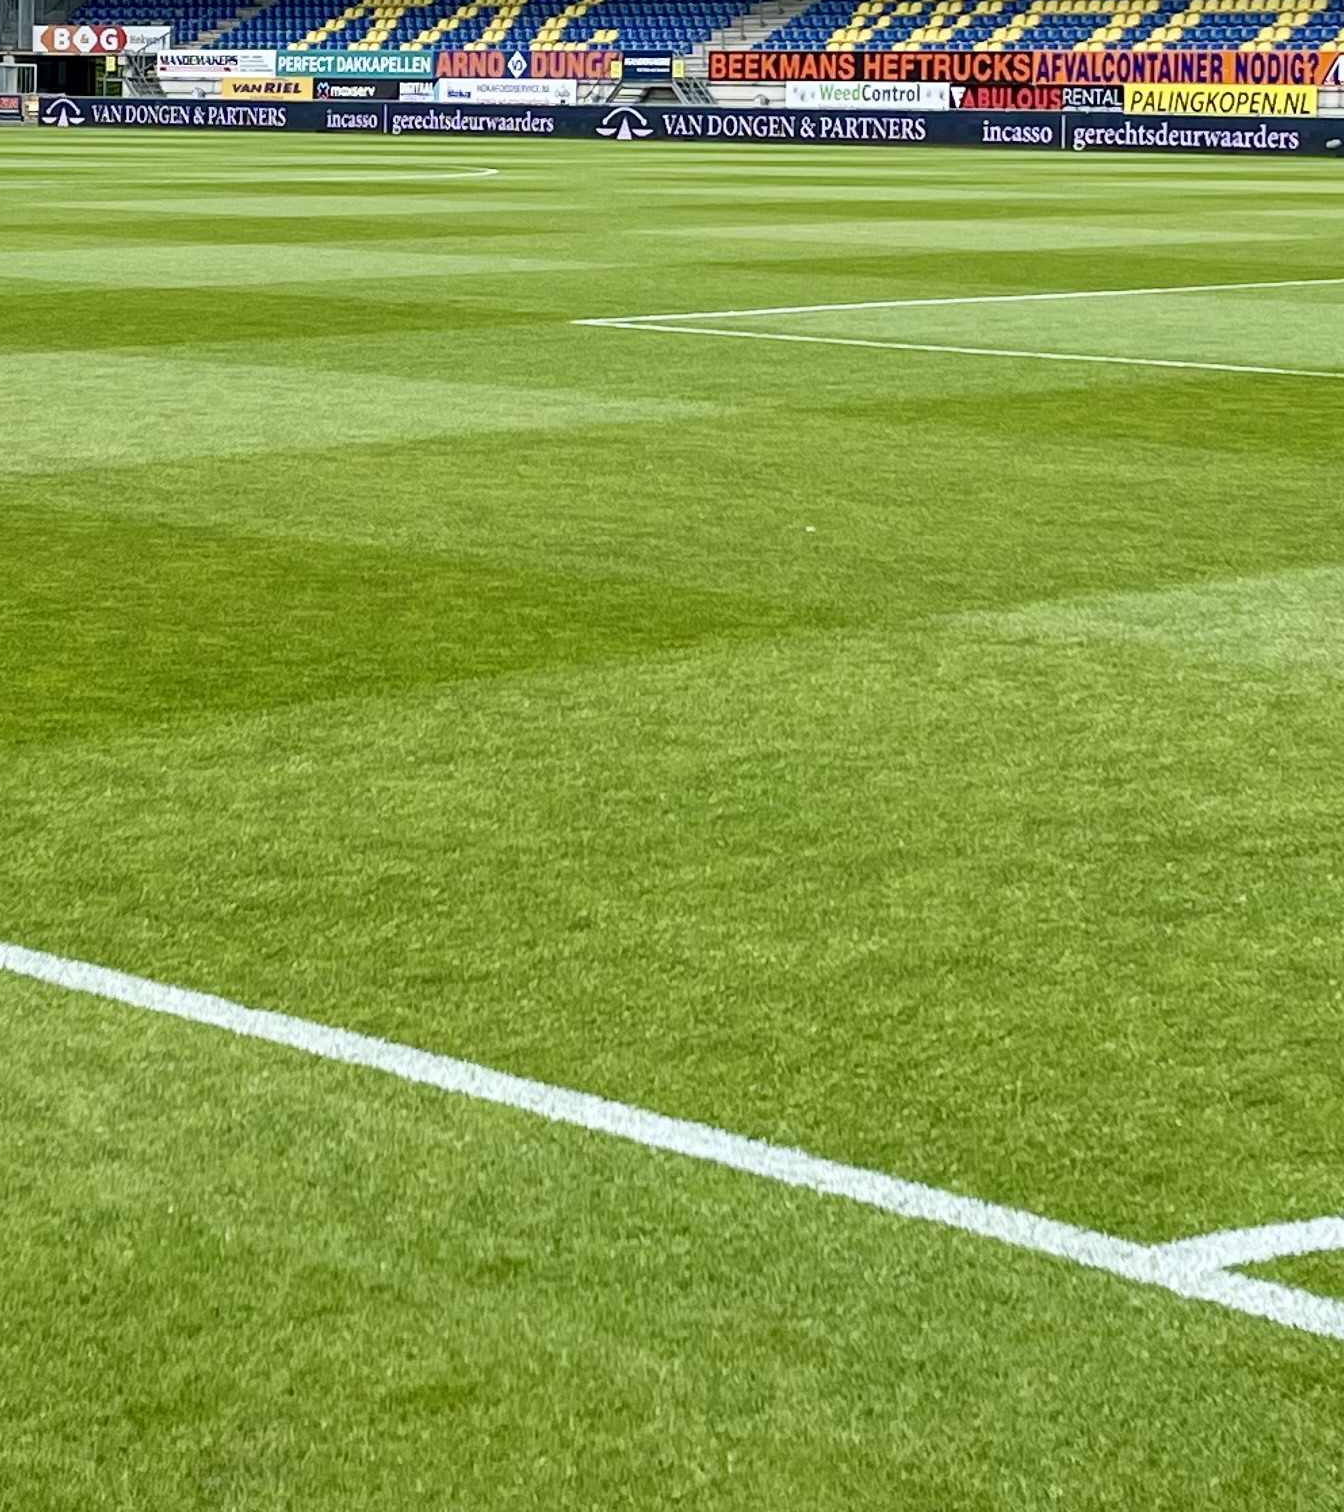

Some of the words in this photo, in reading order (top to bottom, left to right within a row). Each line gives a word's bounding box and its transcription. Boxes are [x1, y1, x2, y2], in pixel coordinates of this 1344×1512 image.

[277, 55, 333, 74] PERFECT
[336, 54, 432, 74] DAKKAPELLEN
[435, 51, 506, 78] ARNO
[709, 53, 856, 80] BEEKMANS
[863, 53, 1031, 81] HEFTRUCKS
[1036, 52, 1224, 83] AFVALCONTAINER
[1235, 52, 1320, 83] NODIG?
[231, 83, 261, 94] VAN
[263, 82, 303, 94] RIEL
[818, 83, 921, 103] WeedControl
[950, 86, 1061, 109] FABULOUS
[1063, 87, 1124, 107] RENTAL
[1129, 89, 1311, 115] PALINGKOPEN.NL
[91, 104, 125, 124] VAN
[125, 104, 191, 125] DONGEN
[193, 107, 205, 126] &
[207, 107, 287, 127] PARTNERS
[325, 109, 378, 129] incasso
[391, 109, 554, 135] gerechtsdeurwaarders
[662, 114, 706, 136] VAN
[706, 114, 796, 138] DONGEN
[799, 116, 816, 139] &
[819, 117, 927, 141] PARTNERS
[981, 120, 1054, 143] incasso
[1072, 121, 1300, 151] gerechtsdeurwaarders
